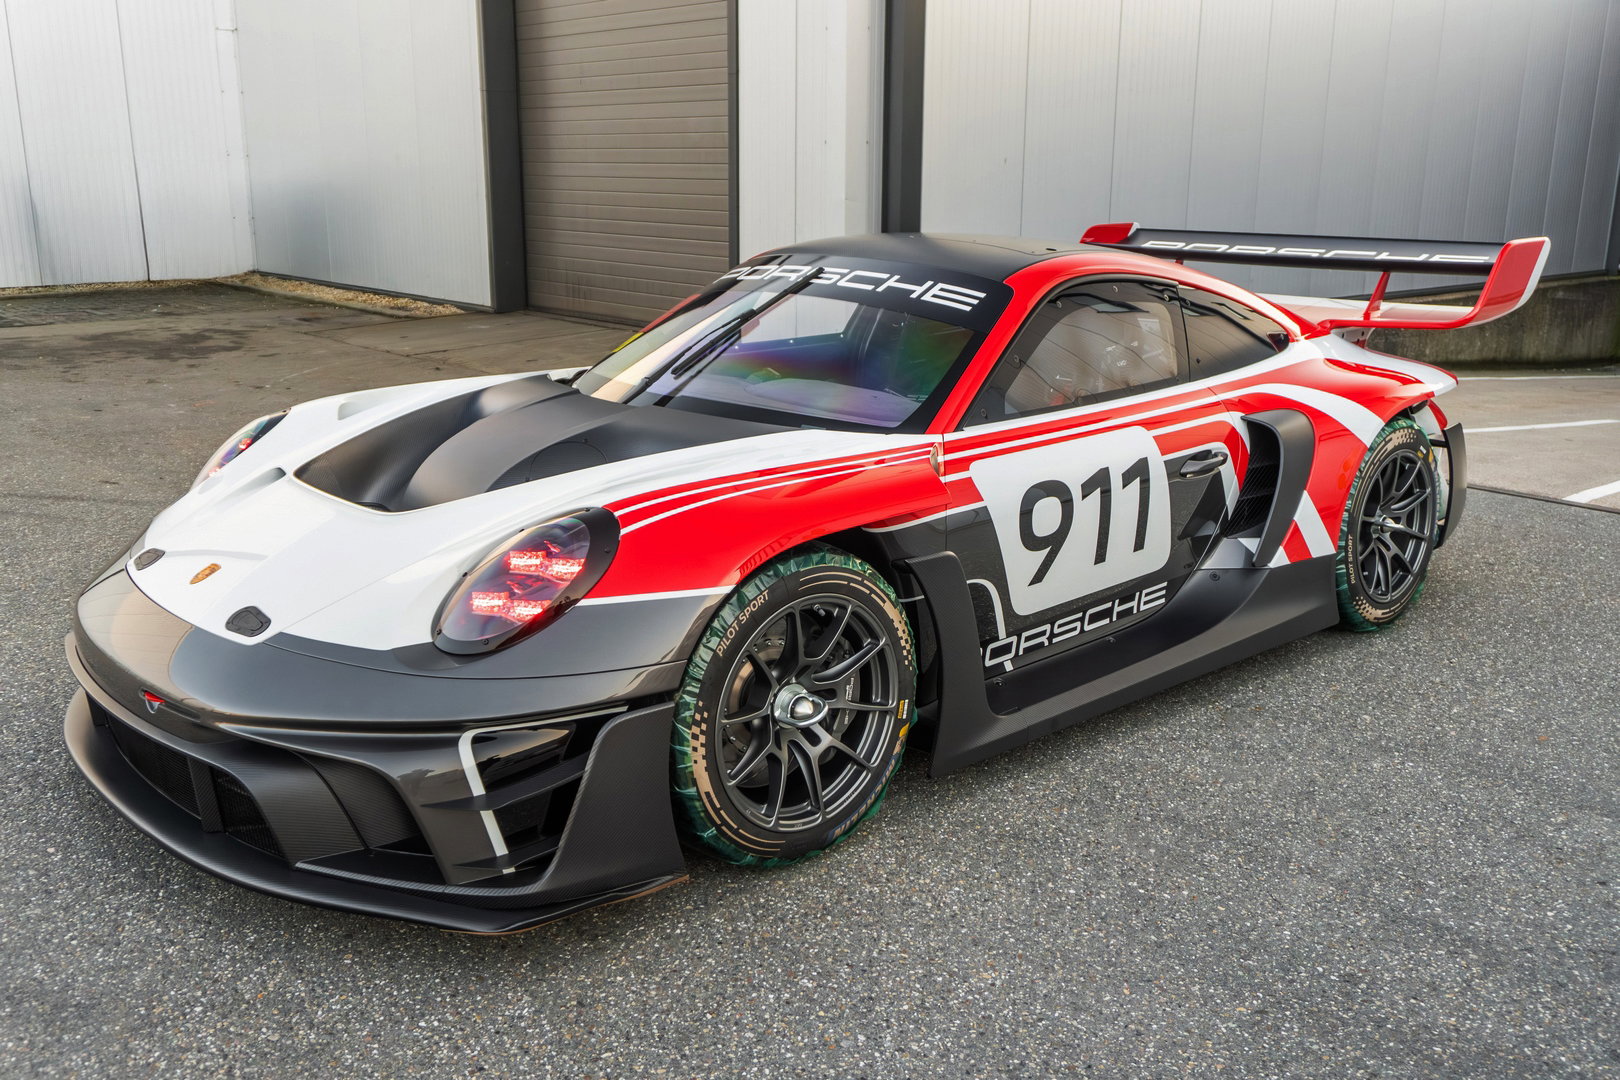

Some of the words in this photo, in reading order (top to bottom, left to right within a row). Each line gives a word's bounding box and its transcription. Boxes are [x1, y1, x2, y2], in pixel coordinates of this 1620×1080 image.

[712, 264, 987, 312] PORSCHE
[1019, 456, 1151, 587] 911
[716, 620, 739, 657] PILOT
[738, 589, 769, 624] SPORT
[980, 581, 1168, 668] ORSCHE
